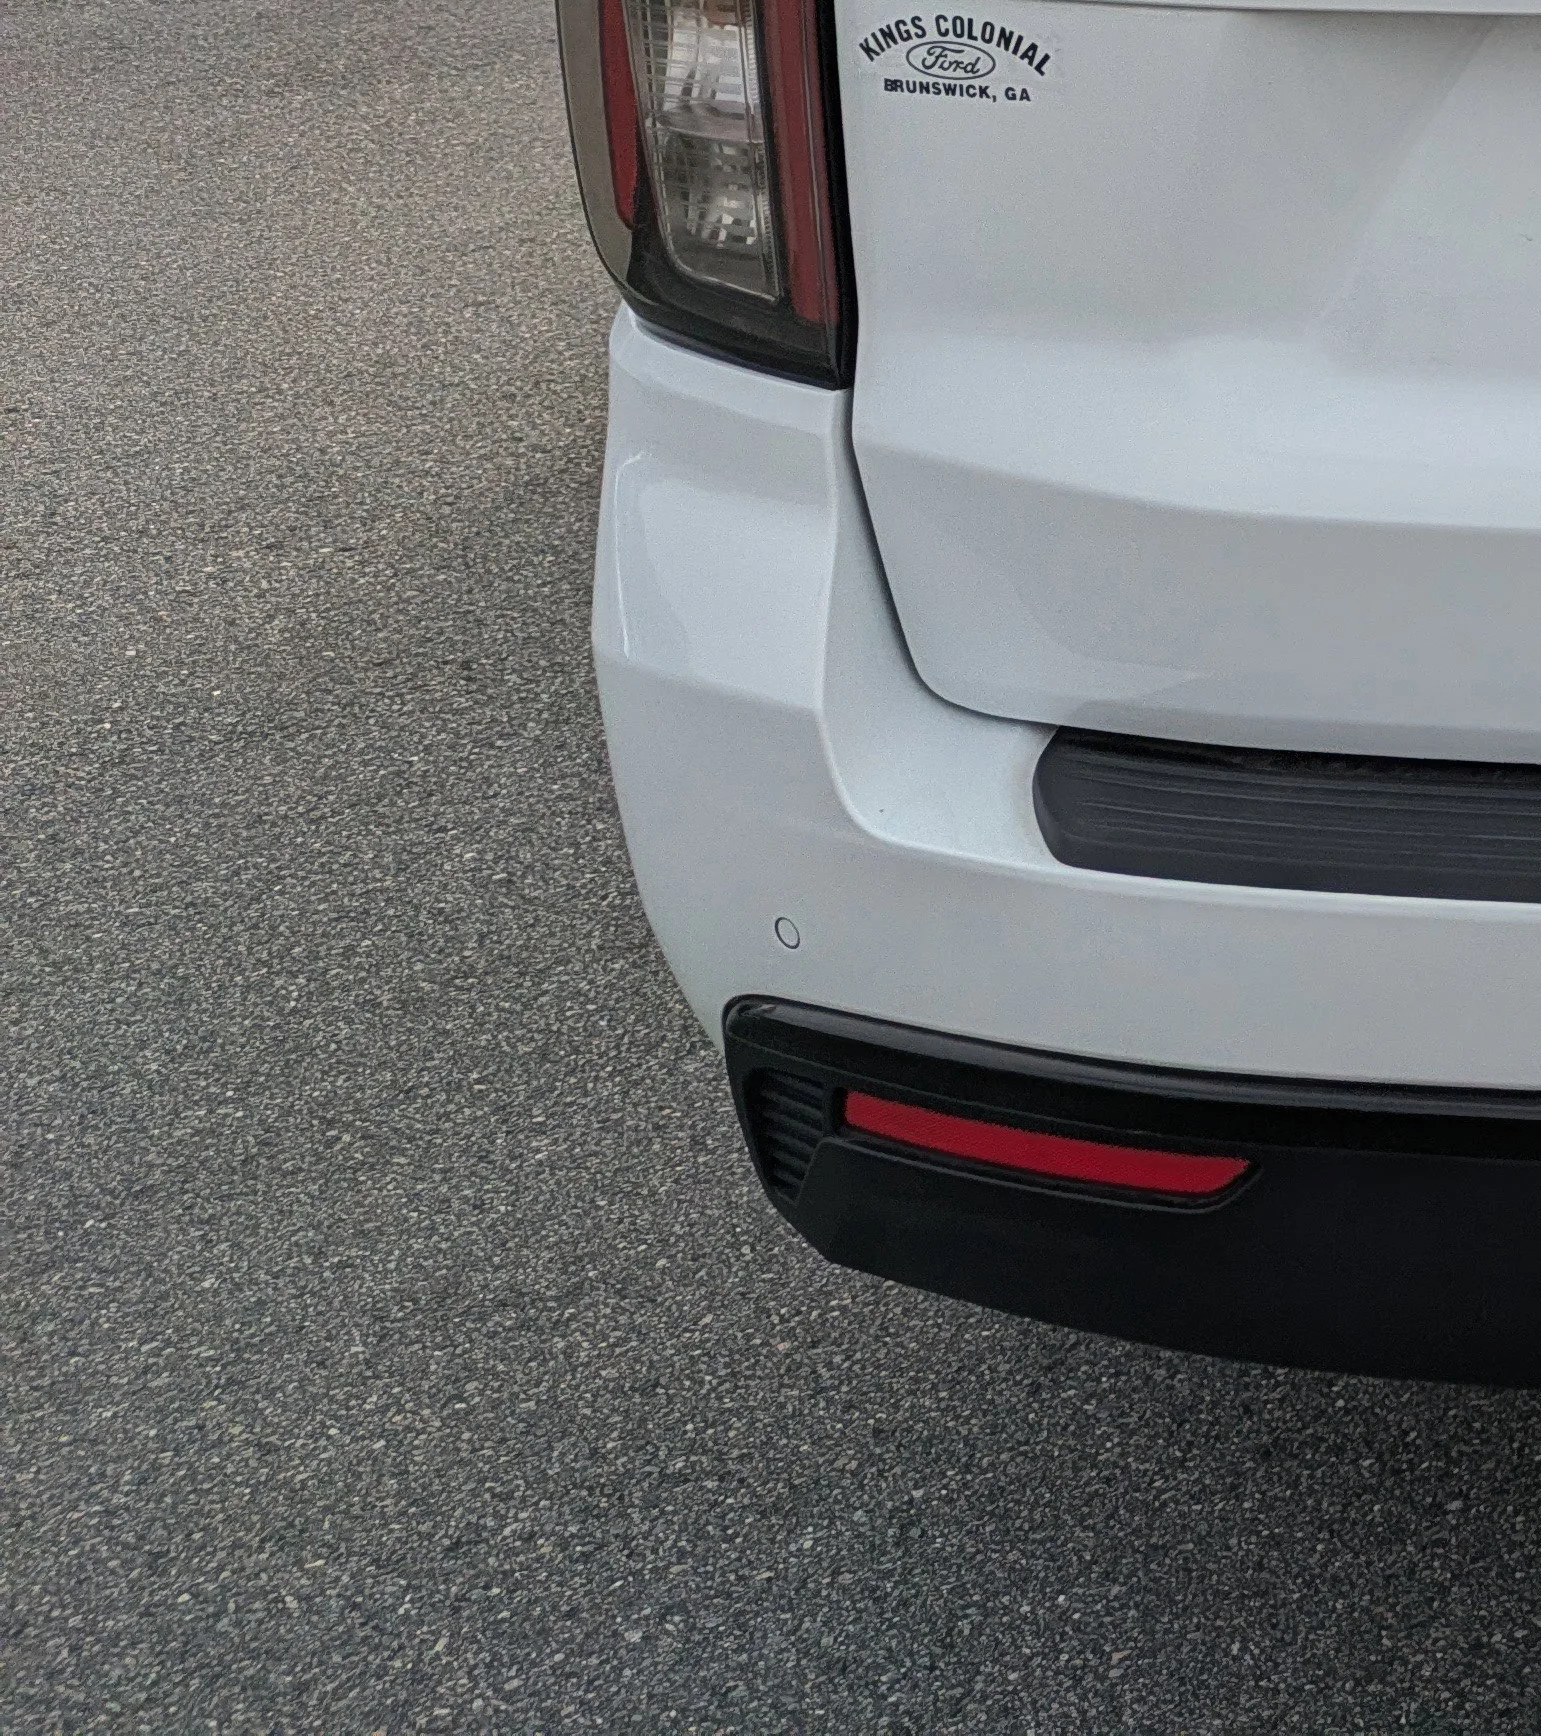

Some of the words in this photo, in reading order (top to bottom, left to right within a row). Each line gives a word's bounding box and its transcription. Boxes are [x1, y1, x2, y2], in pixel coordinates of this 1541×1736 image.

[858, 15, 927, 62] KINGS
[934, 14, 1051, 76] COLONIAL
[921, 45, 981, 75] Ford
[883, 78, 998, 103] BRUNSWICK,
[1004, 87, 1032, 102] GA
